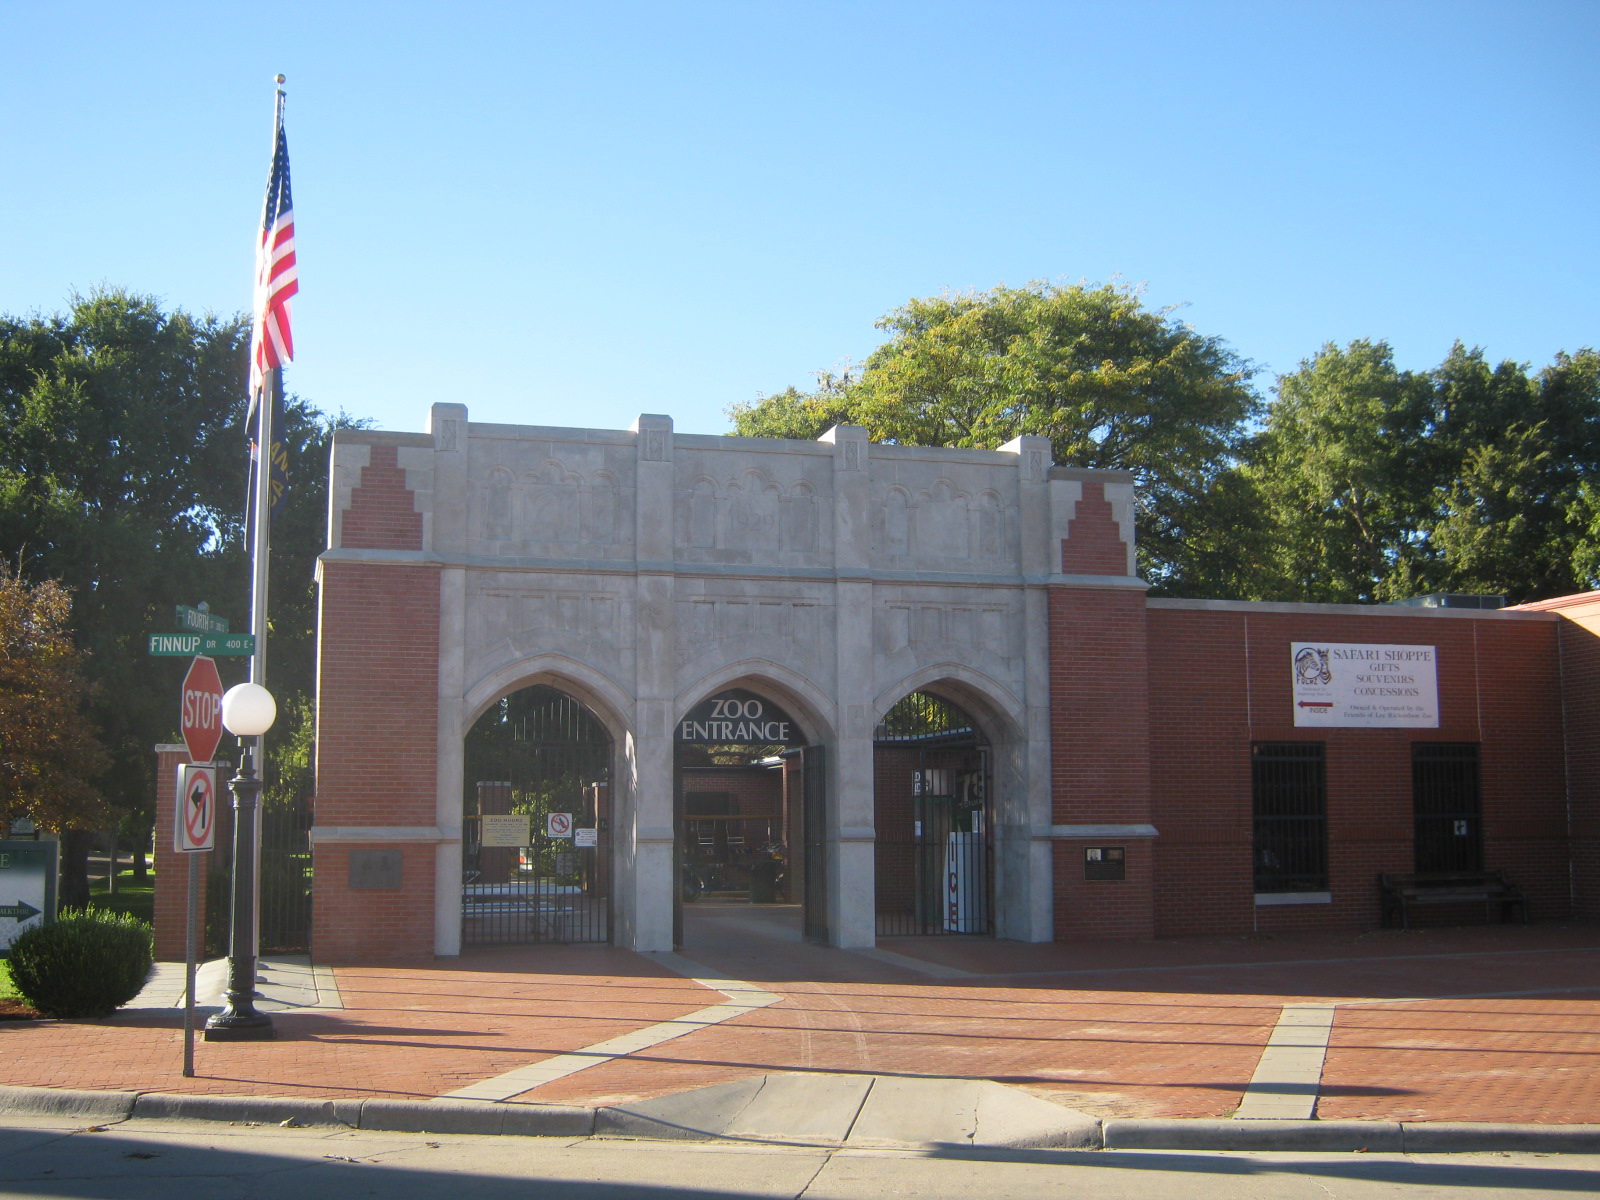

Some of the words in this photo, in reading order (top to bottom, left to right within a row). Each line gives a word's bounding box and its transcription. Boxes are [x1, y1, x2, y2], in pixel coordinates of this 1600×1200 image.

[187, 610, 209, 631] FOURTH
[151, 636, 201, 652] FINNUP
[206, 640, 216, 649] DR
[226, 640, 241, 649] 400
[244, 640, 249, 649] E
[1333, 649, 1380, 660] SAFARI
[1384, 650, 1432, 661] SHOPPE
[1369, 663, 1400, 672] GIFTS
[1356, 674, 1415, 684] SOUVENIRS
[1353, 687, 1419, 697] CONCESSIONS
[185, 689, 220, 729] STOP
[710, 699, 763, 719] ZOO
[682, 721, 789, 740] ENTRANCE
